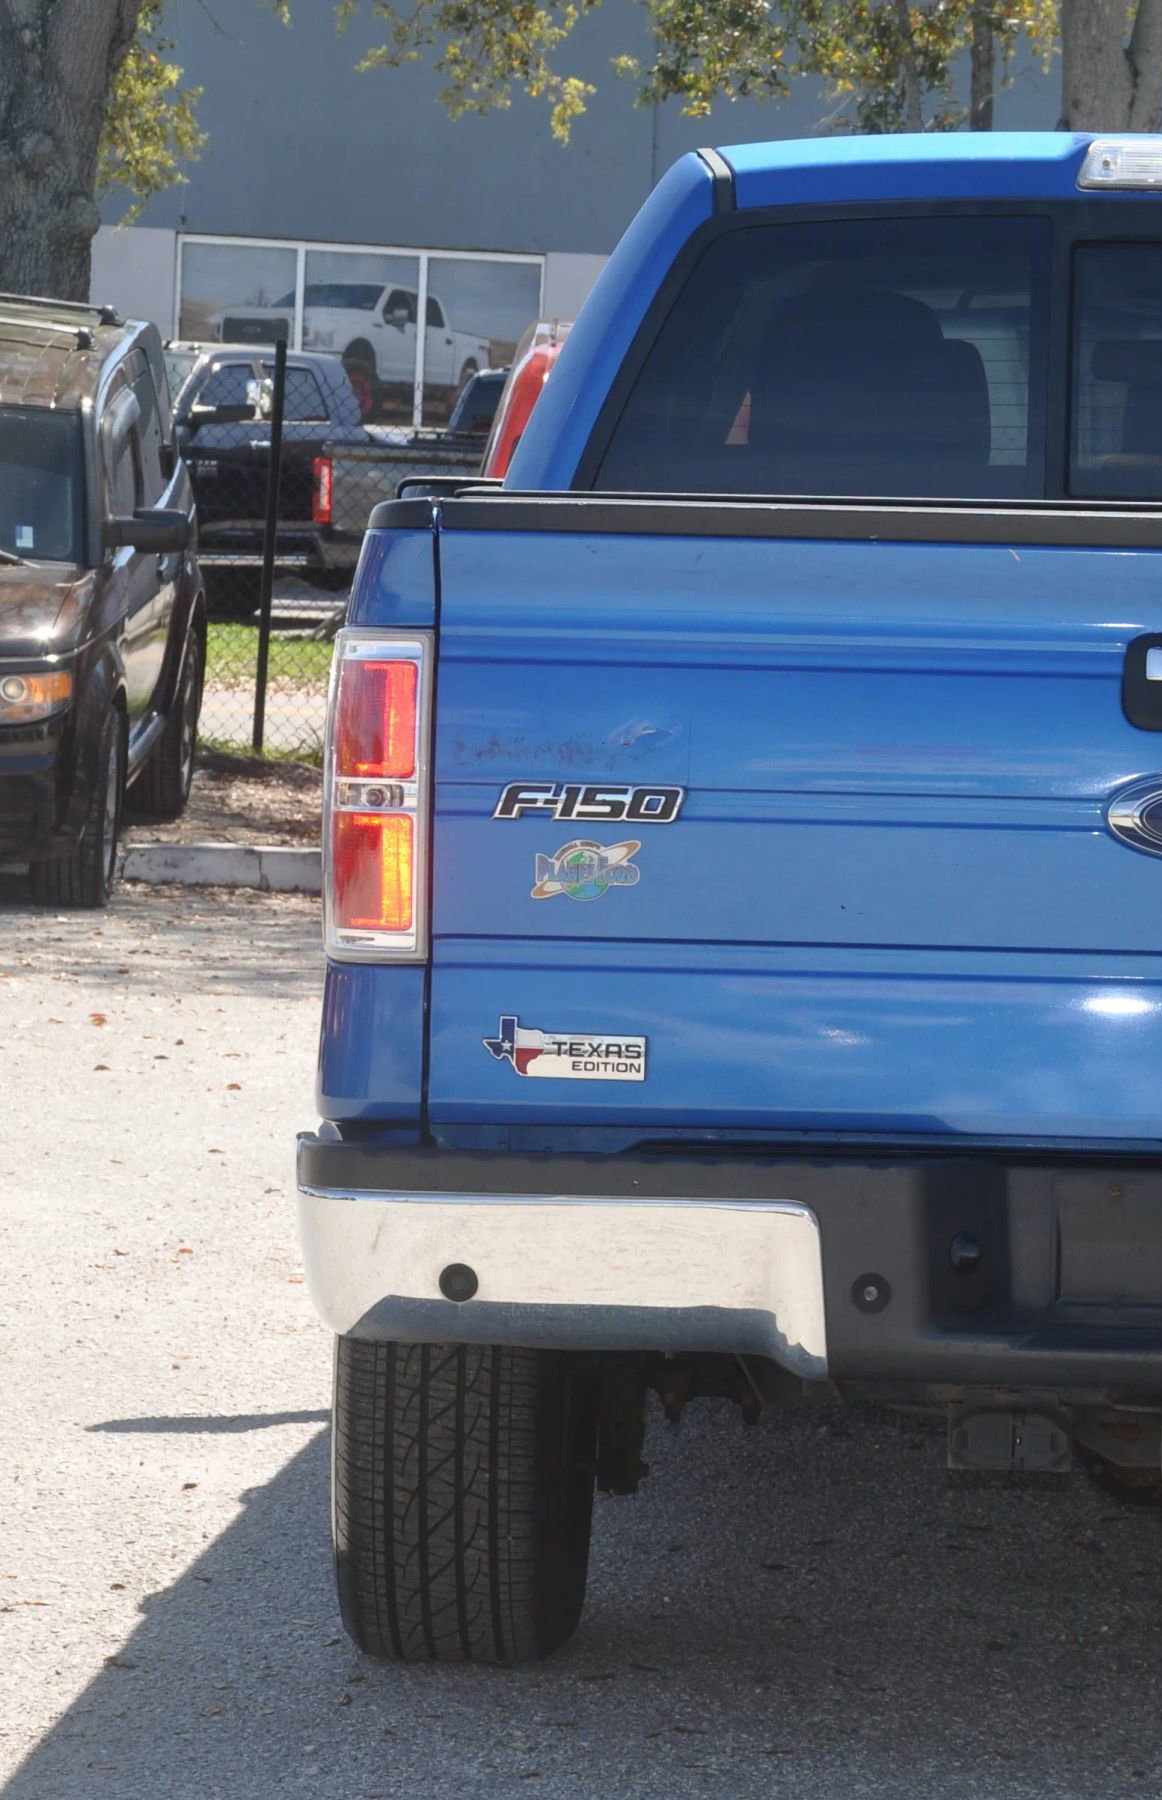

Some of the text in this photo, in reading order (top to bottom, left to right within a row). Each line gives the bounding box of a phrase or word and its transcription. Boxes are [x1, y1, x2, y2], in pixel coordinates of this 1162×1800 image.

[491, 782, 685, 823] F-150
[551, 1041, 642, 1060] TEXAS
[571, 1060, 642, 1074] EDITION
